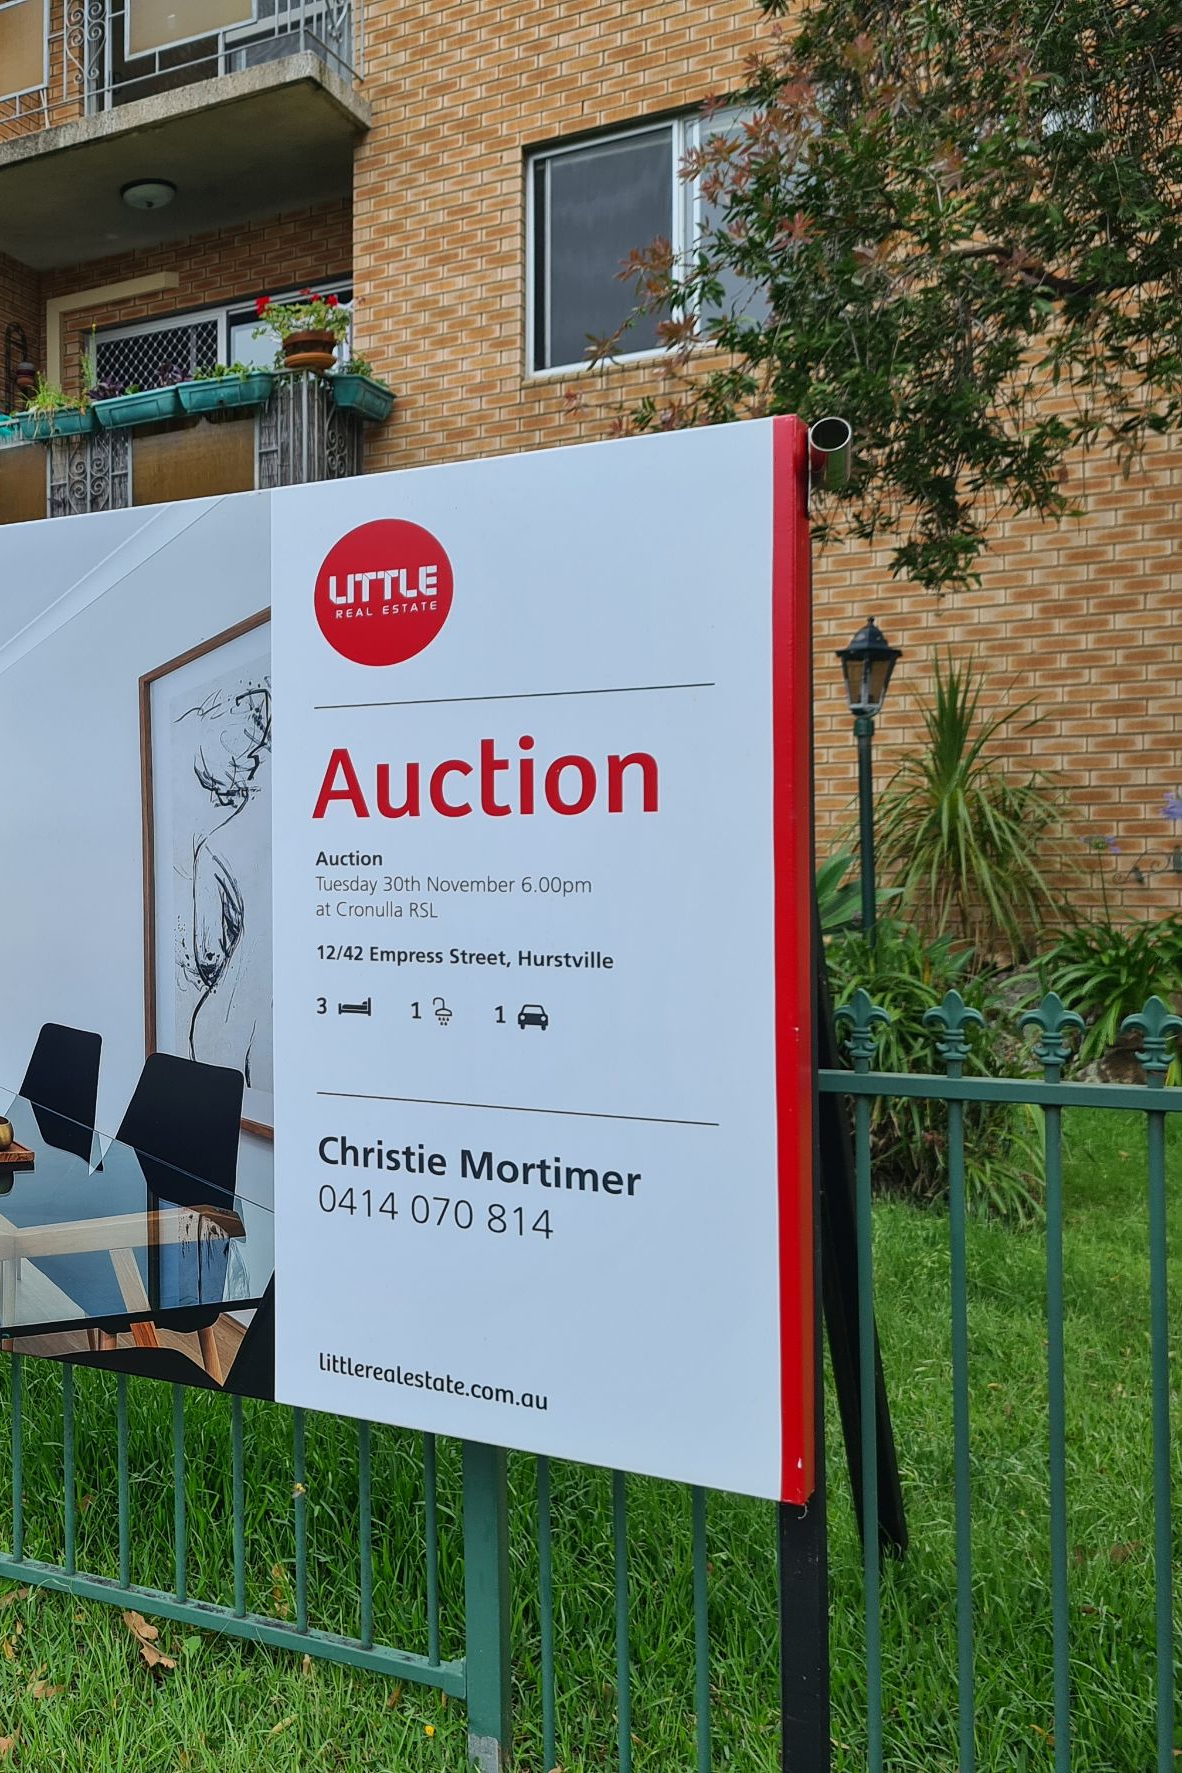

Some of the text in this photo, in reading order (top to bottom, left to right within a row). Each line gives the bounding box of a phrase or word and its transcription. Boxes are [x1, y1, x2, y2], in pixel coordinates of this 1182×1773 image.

[328, 564, 438, 605] LITTLE
[335, 600, 438, 619] REAL ESTATE
[311, 734, 659, 819] Auction
[315, 849, 383, 867] Auction
[314, 874, 592, 898] Tuesday 30th November 6.00pm
[315, 900, 439, 919] at Cronulla RSL
[316, 944, 614, 970] 12/42 Empress Street, Hurstville
[316, 996, 507, 1024] 3 1 1
[318, 1135, 642, 1197] Christie Mortimer
[318, 1184, 554, 1240] 0414 070 814
[319, 1352, 548, 1411] littlerealestate.com.au
